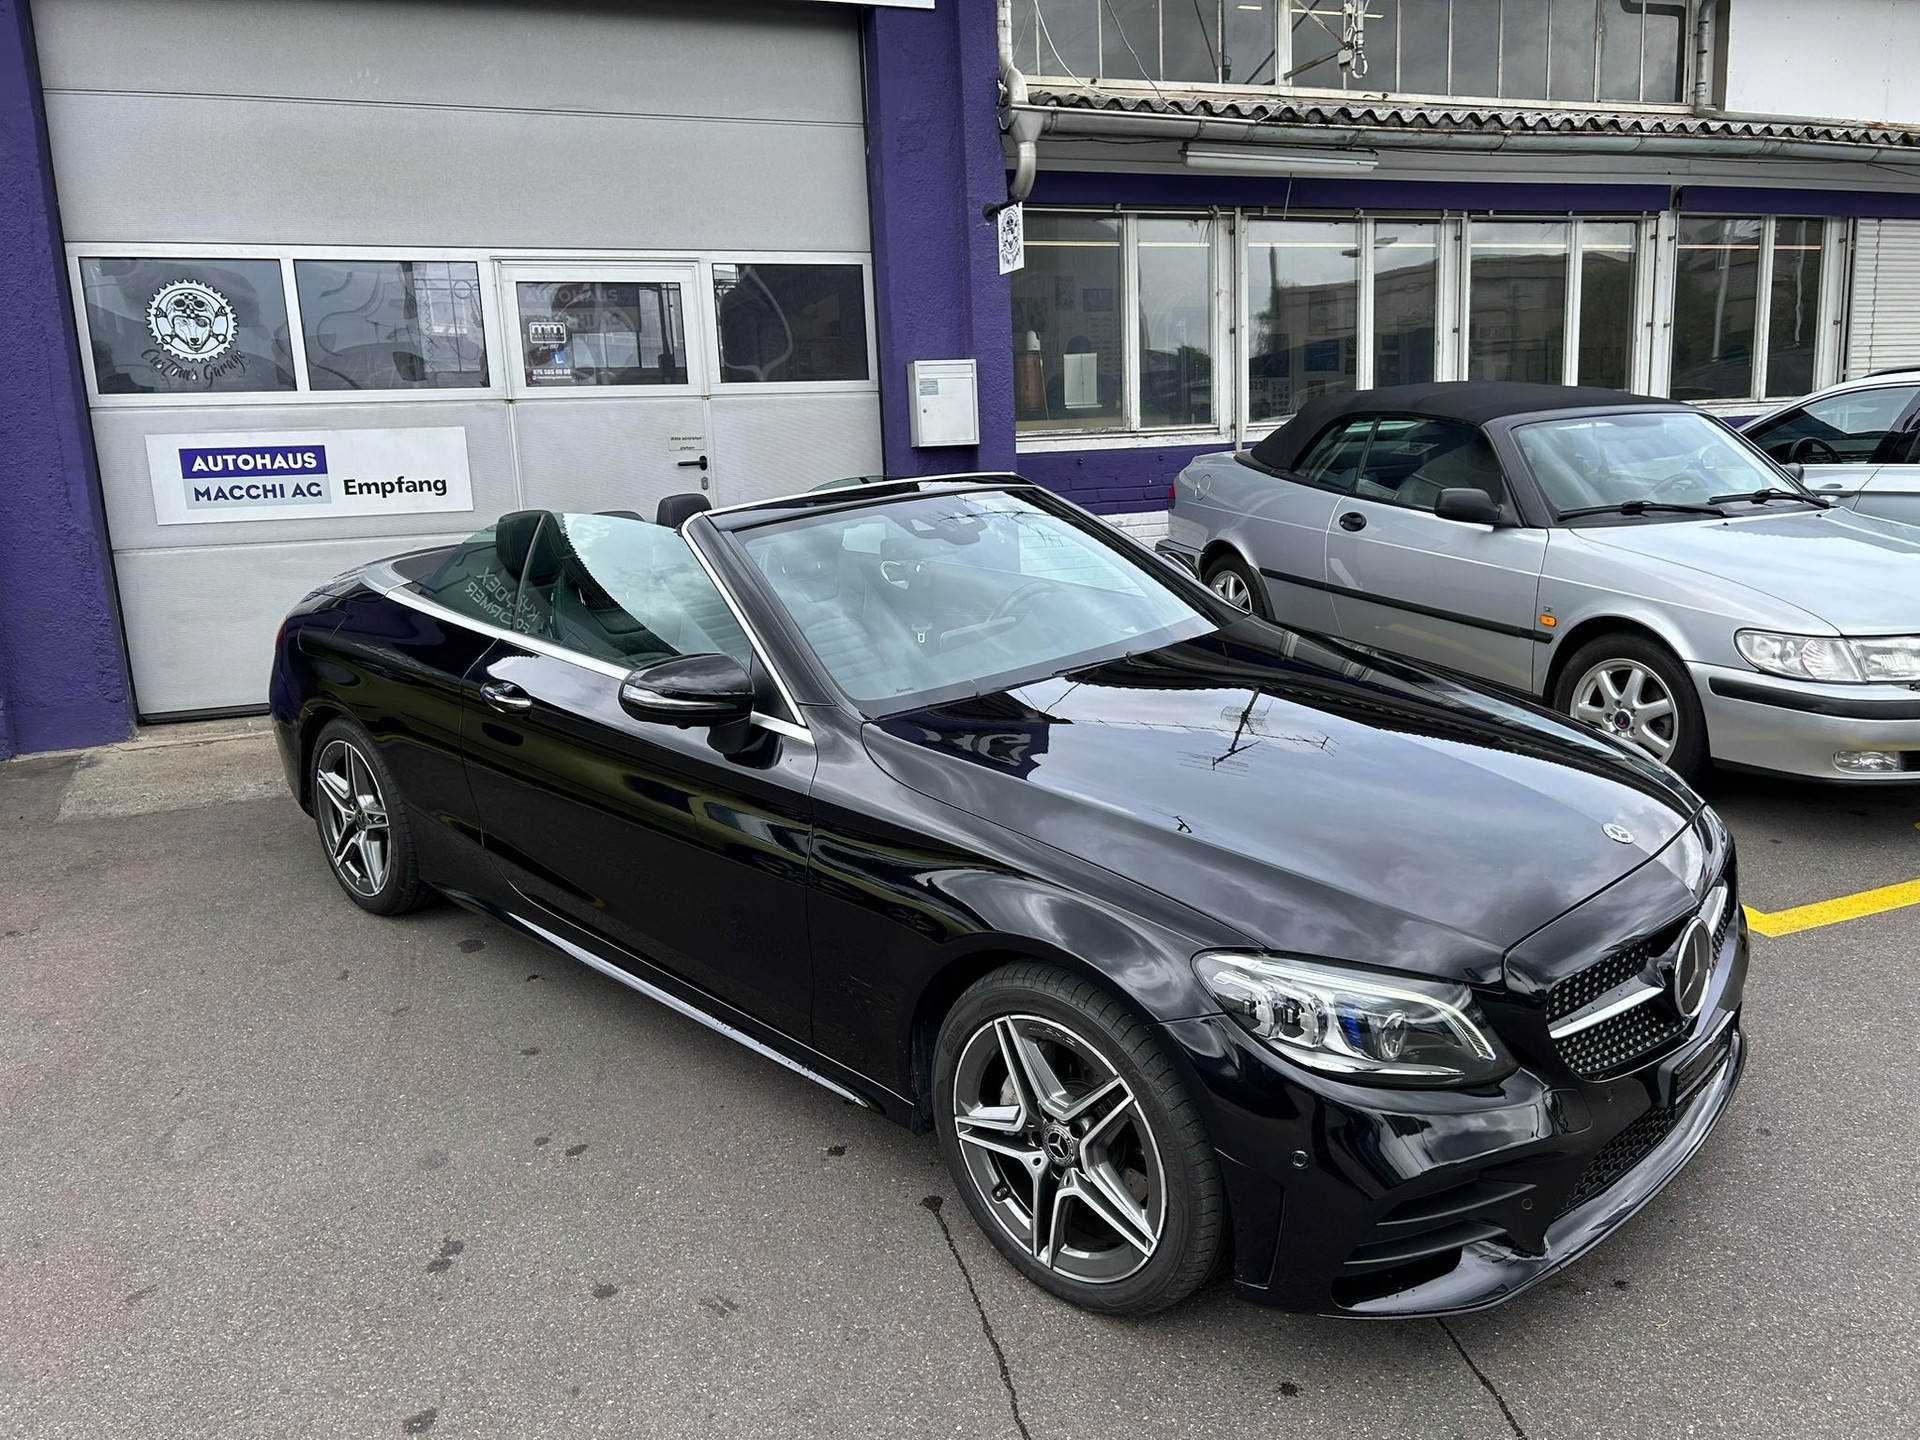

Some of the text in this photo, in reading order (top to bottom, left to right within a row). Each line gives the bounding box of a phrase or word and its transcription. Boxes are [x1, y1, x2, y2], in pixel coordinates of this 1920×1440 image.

[203, 350, 246, 389] Garage
[191, 451, 318, 472] AUTOHAUS
[194, 481, 323, 502] MACCHI AG
[344, 475, 448, 499] Empfang
